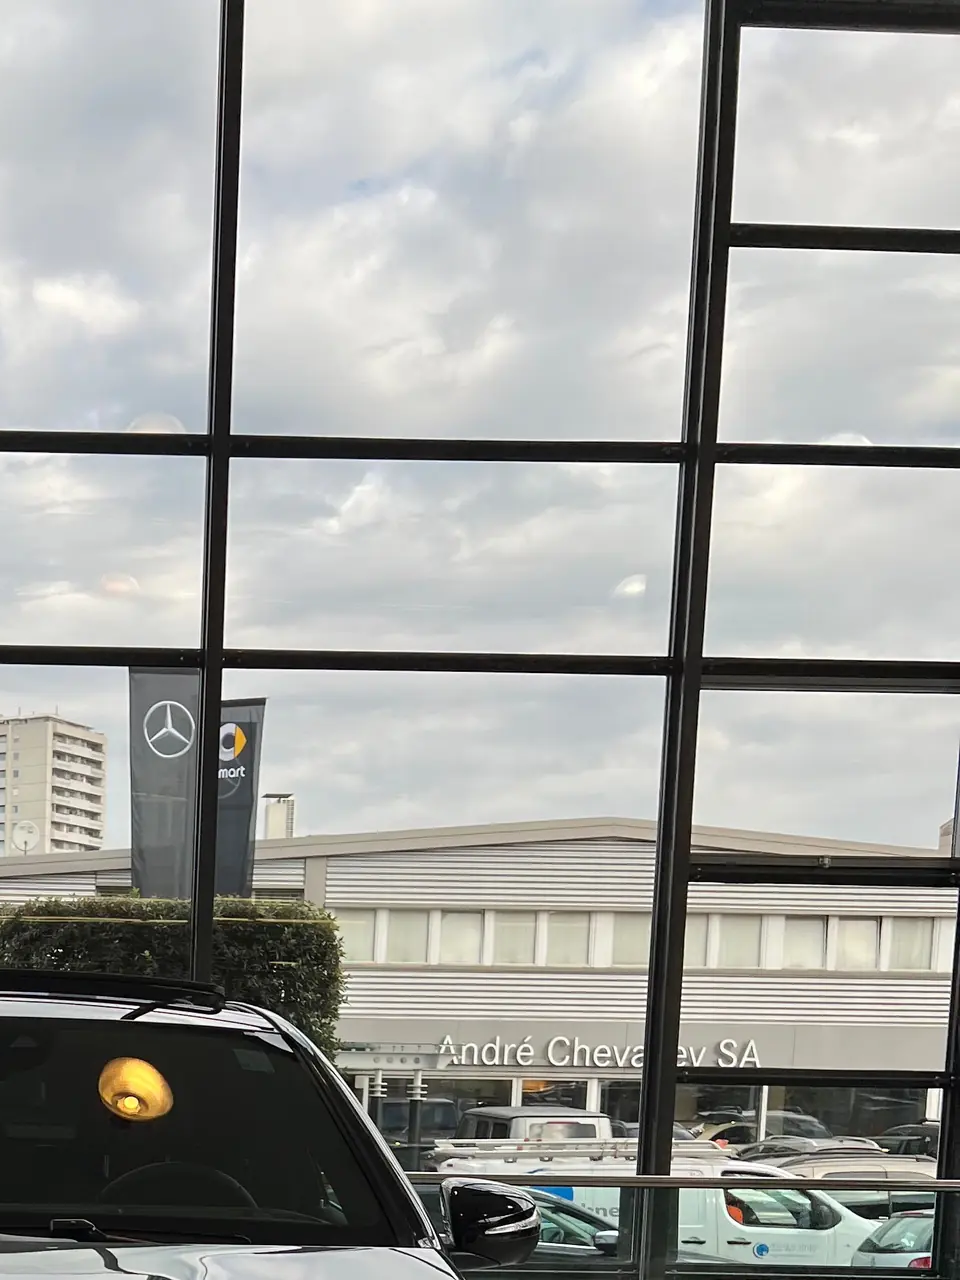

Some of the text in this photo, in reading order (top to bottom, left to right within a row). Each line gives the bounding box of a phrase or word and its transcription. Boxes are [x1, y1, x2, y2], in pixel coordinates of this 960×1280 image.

[218, 765, 246, 779] mart
[439, 1035, 762, 1068] André Chevaey SA
